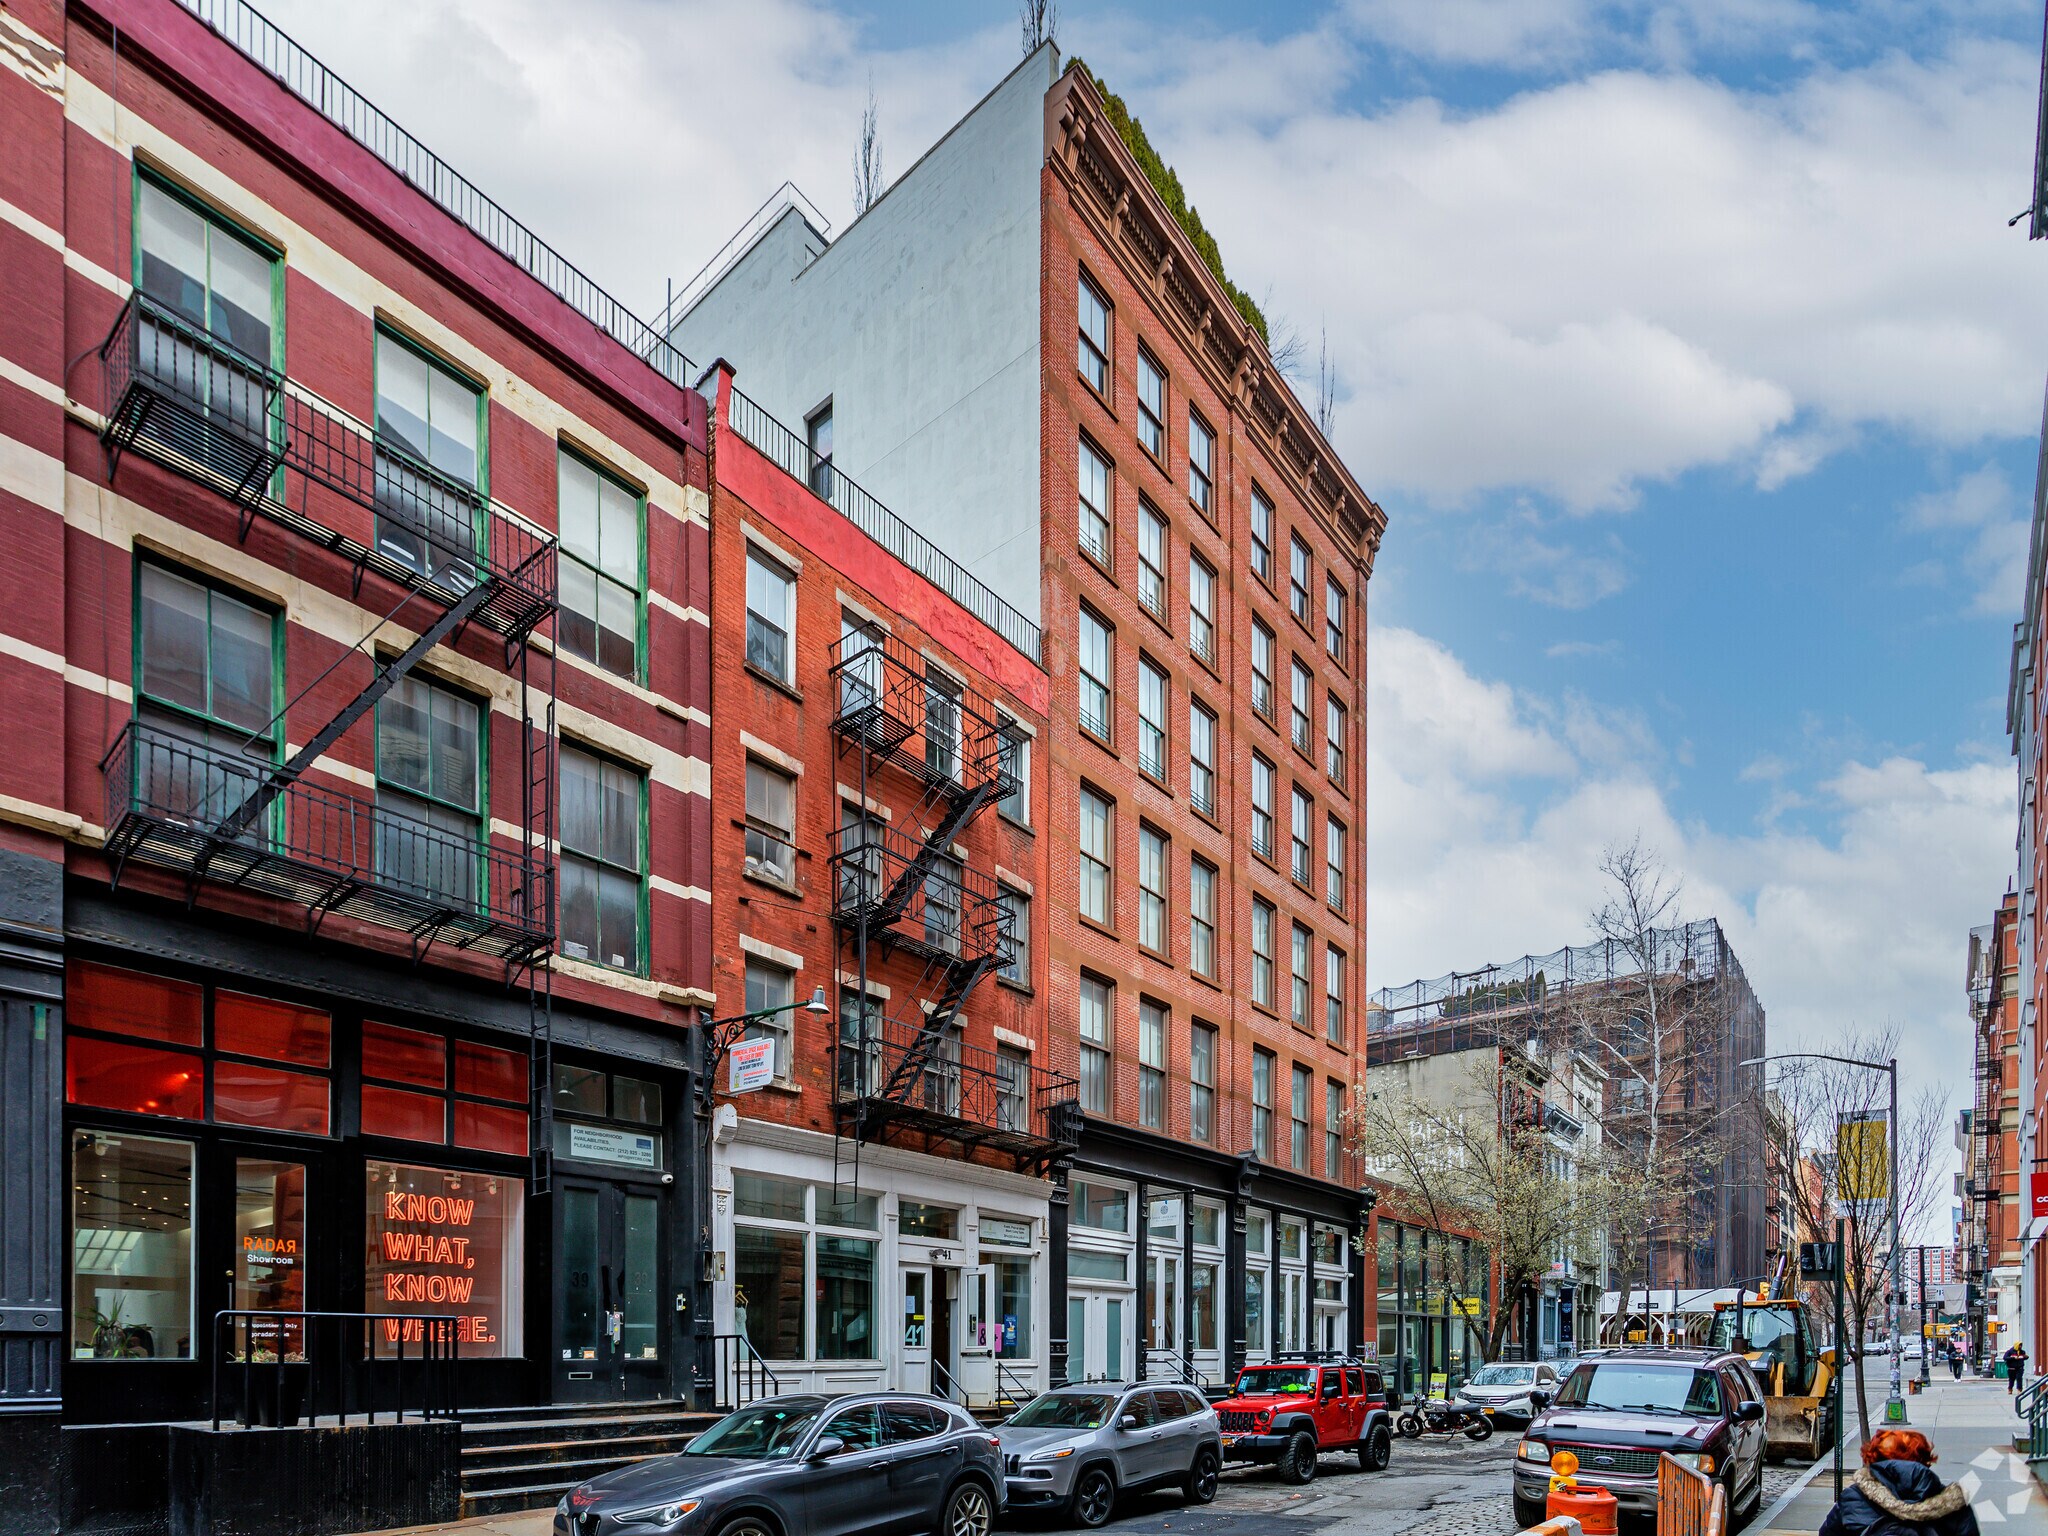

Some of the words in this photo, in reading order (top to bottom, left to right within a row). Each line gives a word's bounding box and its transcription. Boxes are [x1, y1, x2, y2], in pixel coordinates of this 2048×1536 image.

[584, 1130, 623, 1140] NEIGHBORHOOD
[573, 1142, 592, 1150] PLEASE
[385, 1191, 474, 1226] KNOW
[247, 1254, 294, 1264] Showroom
[383, 1232, 475, 1269] WHAT,
[942, 1249, 951, 1260] 41
[572, 1271, 589, 1288] 39
[384, 1273, 473, 1304] KNOW
[905, 1324, 925, 1346] 41
